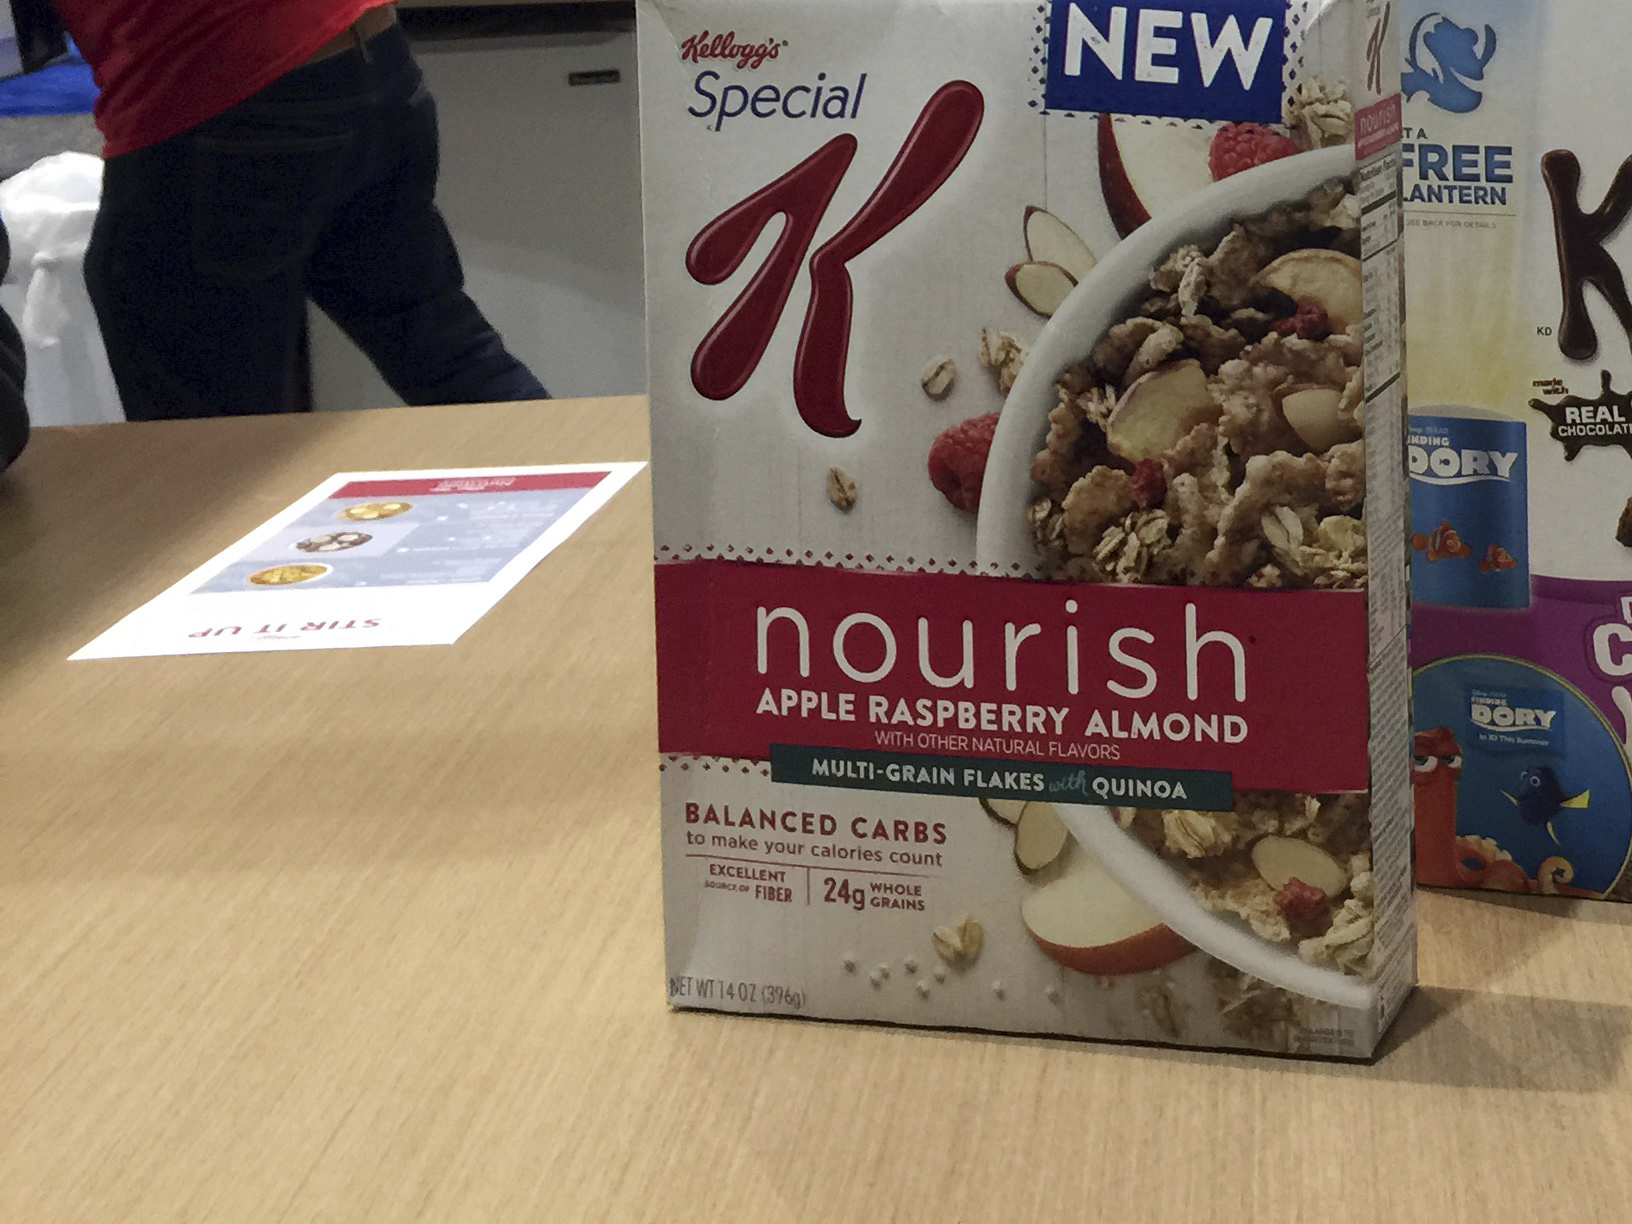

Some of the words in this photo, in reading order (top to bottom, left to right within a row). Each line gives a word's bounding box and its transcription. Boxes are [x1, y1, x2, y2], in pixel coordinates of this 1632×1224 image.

[681, 30, 780, 69] Kellogg's
[1062, 2, 1274, 91] NEW
[688, 70, 867, 132] Special
[1417, 128, 1428, 139] A
[1402, 143, 1512, 183] FREE
[1403, 184, 1506, 205] ANTERN
[686, 80, 984, 437] K
[1537, 327, 1552, 336] KD
[1532, 378, 1562, 387] made
[1566, 406, 1626, 423] REAL
[1409, 446, 1518, 478] DORY
[188, 627, 241, 638] UP
[255, 623, 288, 634] IT
[300, 619, 380, 631] STIR
[757, 599, 1245, 702] nourish
[756, 688, 855, 721] APPLE
[869, 696, 1069, 734] RASPBERRY
[1085, 709, 1248, 743] ALMOND
[1472, 704, 1556, 728] DORY
[875, 730, 914, 747] WITH
[917, 732, 969, 751] OTHER
[973, 736, 1044, 756] NATURAL
[1050, 741, 1120, 760] FLAVORS
[812, 758, 954, 786] MULTI-GRAIN
[963, 769, 1045, 792] FLAKES
[1048, 769, 1087, 796] with
[1092, 777, 1187, 799] QUINOA
[685, 802, 838, 835] BALANCED
[851, 817, 947, 844] CARBS
[687, 829, 706, 845] to
[712, 832, 758, 850] make
[764, 840, 805, 857] your
[810, 842, 883, 863] calories
[889, 851, 943, 867] count
[709, 864, 786, 882] EXCELLENT
[755, 885, 792, 902] FIBER
[823, 877, 866, 910] 24g
[870, 882, 922, 897] WHOLE
[870, 896, 925, 911] GRAINS
[669, 976, 692, 998] NET
[696, 978, 714, 999] WT
[718, 981, 735, 1001] 14
[738, 983, 757, 1002] OZ
[761, 984, 806, 1008] (396g)
